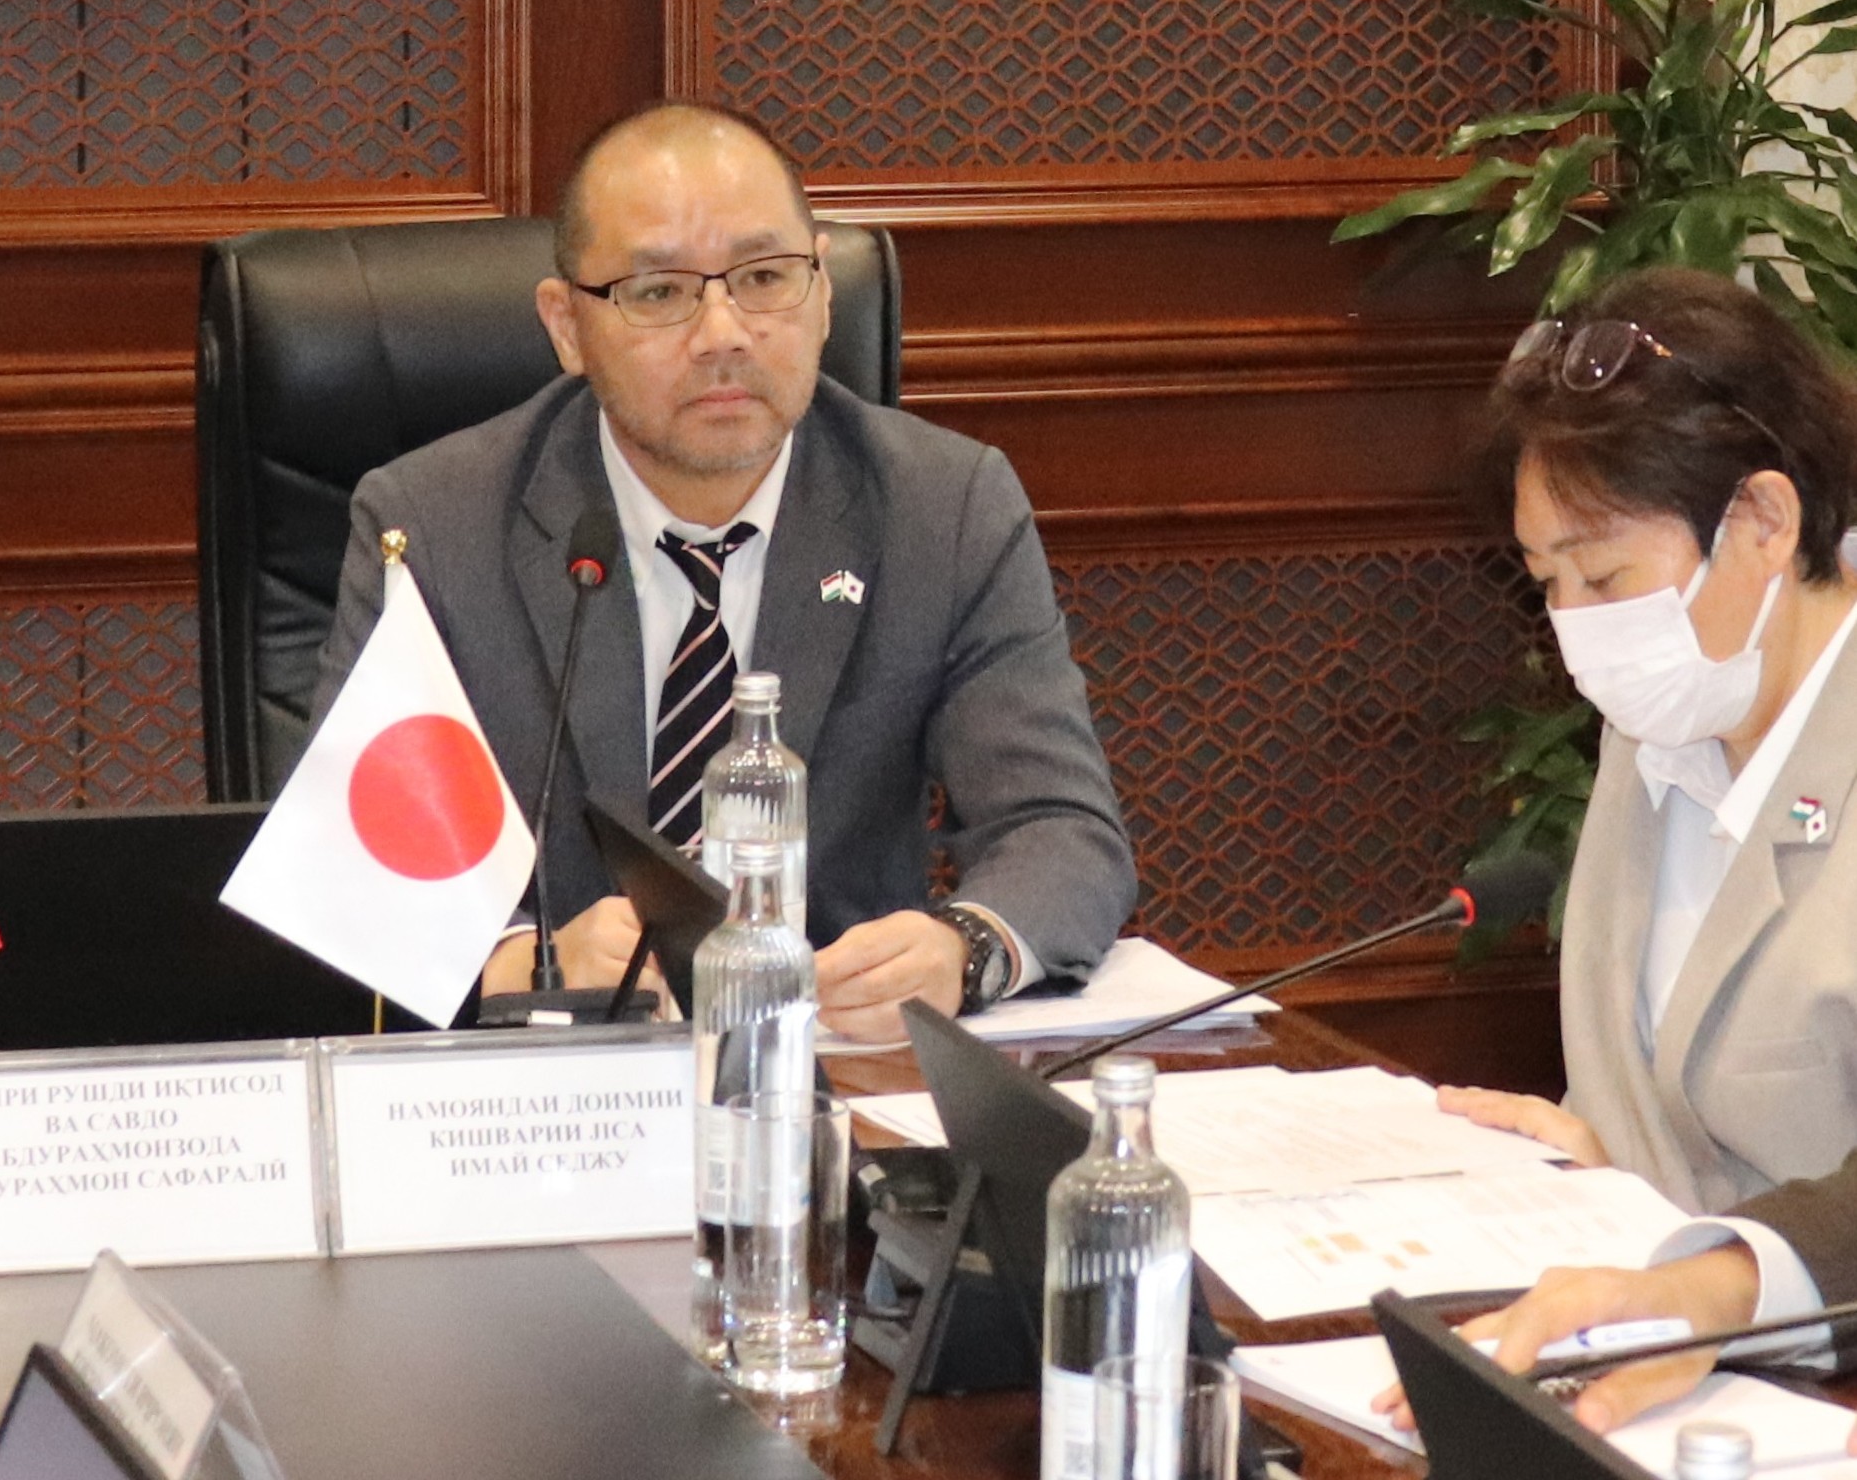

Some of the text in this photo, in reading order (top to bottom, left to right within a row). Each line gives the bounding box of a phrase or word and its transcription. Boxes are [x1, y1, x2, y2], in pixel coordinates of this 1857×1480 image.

[46, 1081, 146, 1105] РУШДИ
[153, 1073, 285, 1099] ИҚТИСОД
[389, 1089, 683, 1121] НАМОЯНДАИ ДОИМИИ
[45, 1108, 179, 1135] ВА САВДО
[430, 1123, 582, 1149] КИШВАРИИ
[450, 1150, 630, 1178] ИМАЙ СЕДЖУ
